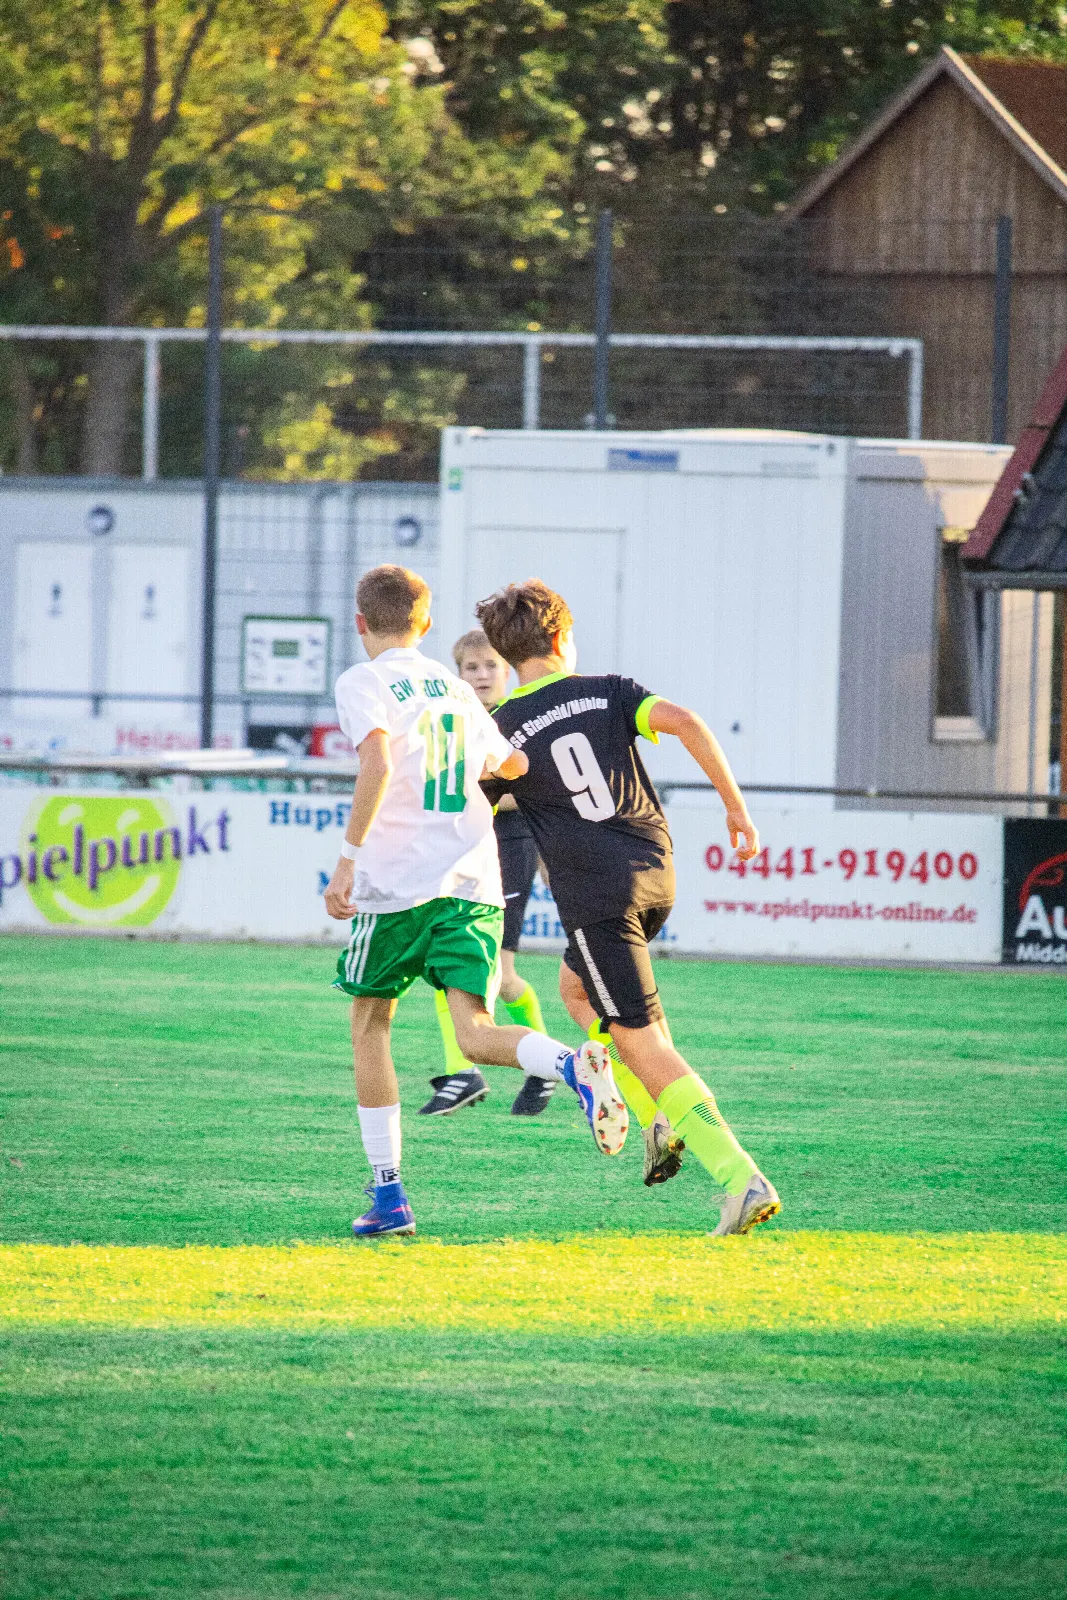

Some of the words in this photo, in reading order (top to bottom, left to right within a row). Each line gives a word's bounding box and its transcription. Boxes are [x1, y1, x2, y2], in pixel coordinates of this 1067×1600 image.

[389, 678, 416, 703] GW
[521, 696, 608, 737] Steinfeld/Mühlen
[417, 709, 466, 813] 10
[550, 732, 616, 823] 9
[704, 844, 980, 884] 04441-919400
[703, 898, 978, 924] www.spielpunkt-online.de
